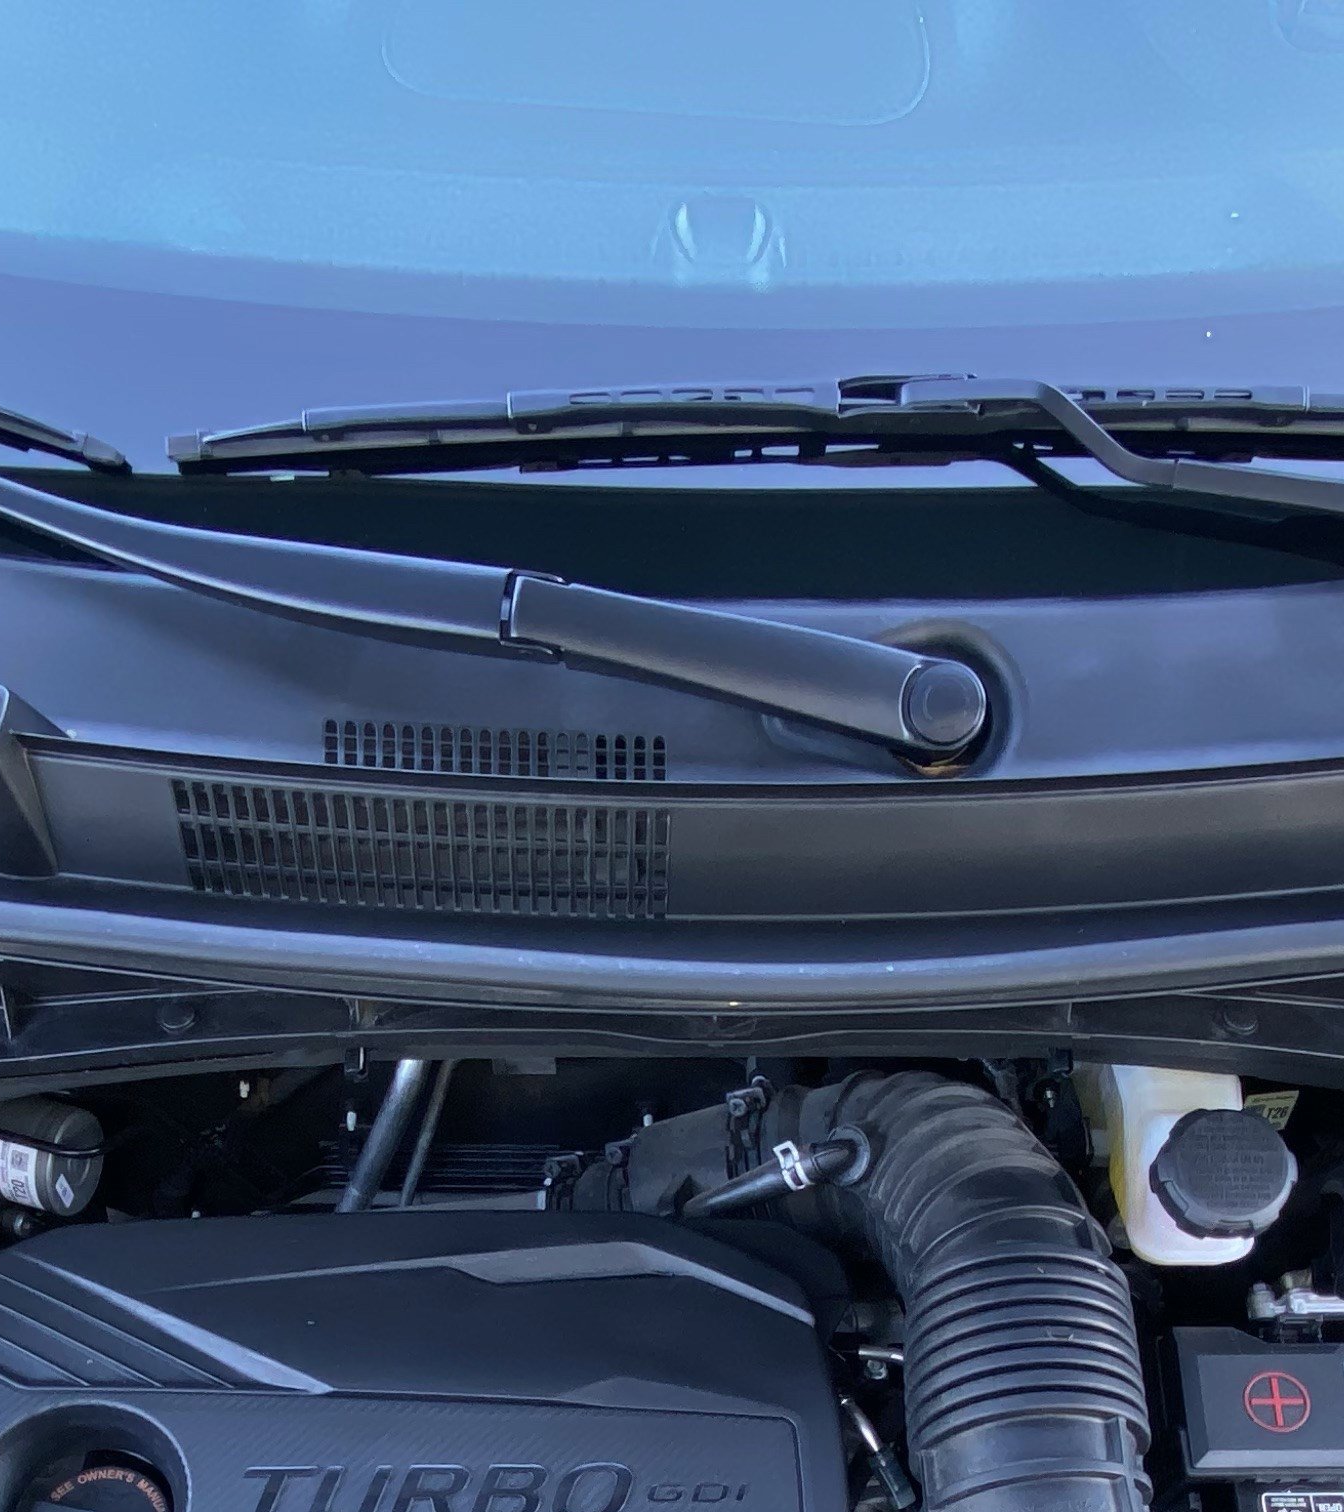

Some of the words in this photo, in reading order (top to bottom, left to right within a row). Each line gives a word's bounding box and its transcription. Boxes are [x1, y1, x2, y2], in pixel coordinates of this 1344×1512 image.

[51, 1481, 74, 1501] SEE
[77, 1469, 135, 1484] OWNER'S
[646, 1482, 750, 1502] GDI
